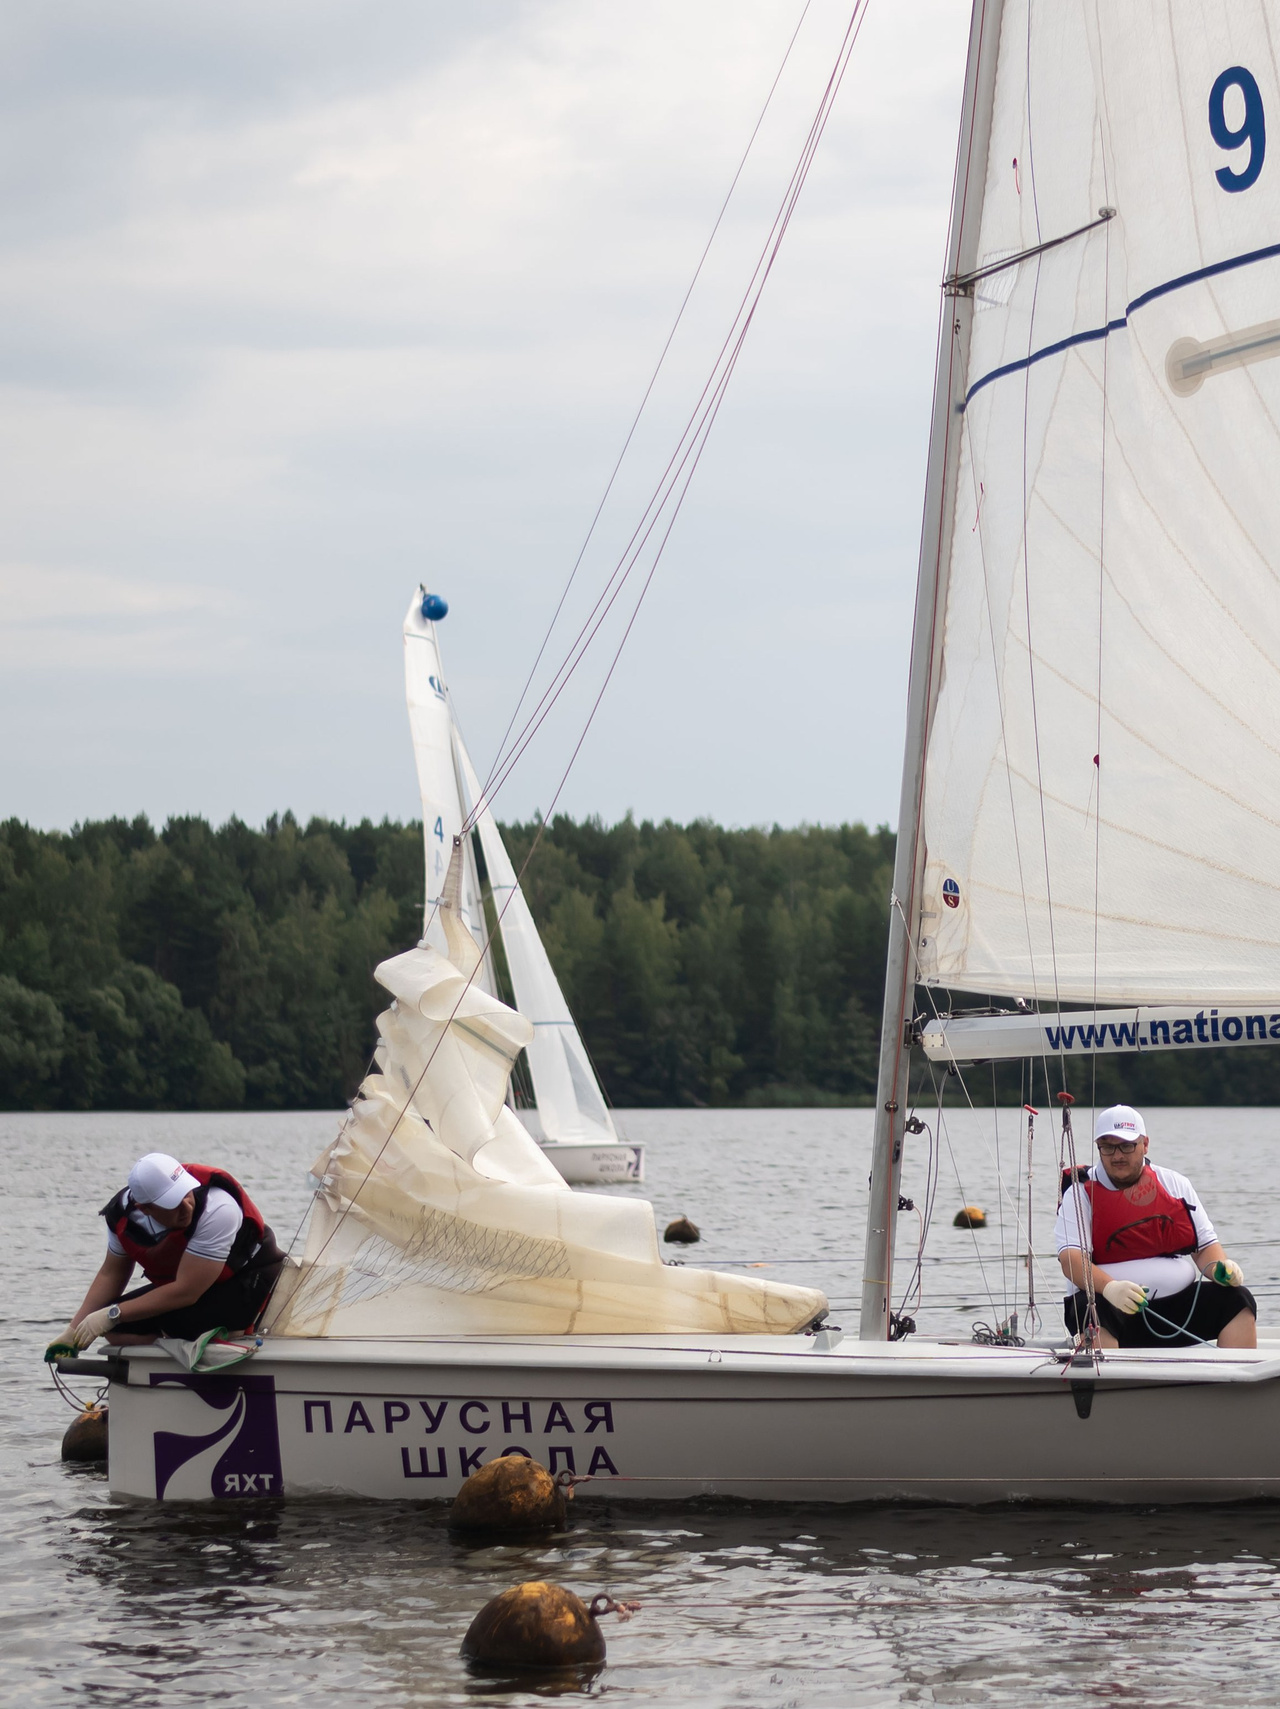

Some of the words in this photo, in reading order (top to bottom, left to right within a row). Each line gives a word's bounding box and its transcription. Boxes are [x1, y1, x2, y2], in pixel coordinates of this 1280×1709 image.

[1209, 66, 1265, 193] 9
[433, 816, 444, 844] 4
[303, 1400, 615, 1434] ПАРУСНАЯ
[224, 1474, 274, 1492] ЯХТ
